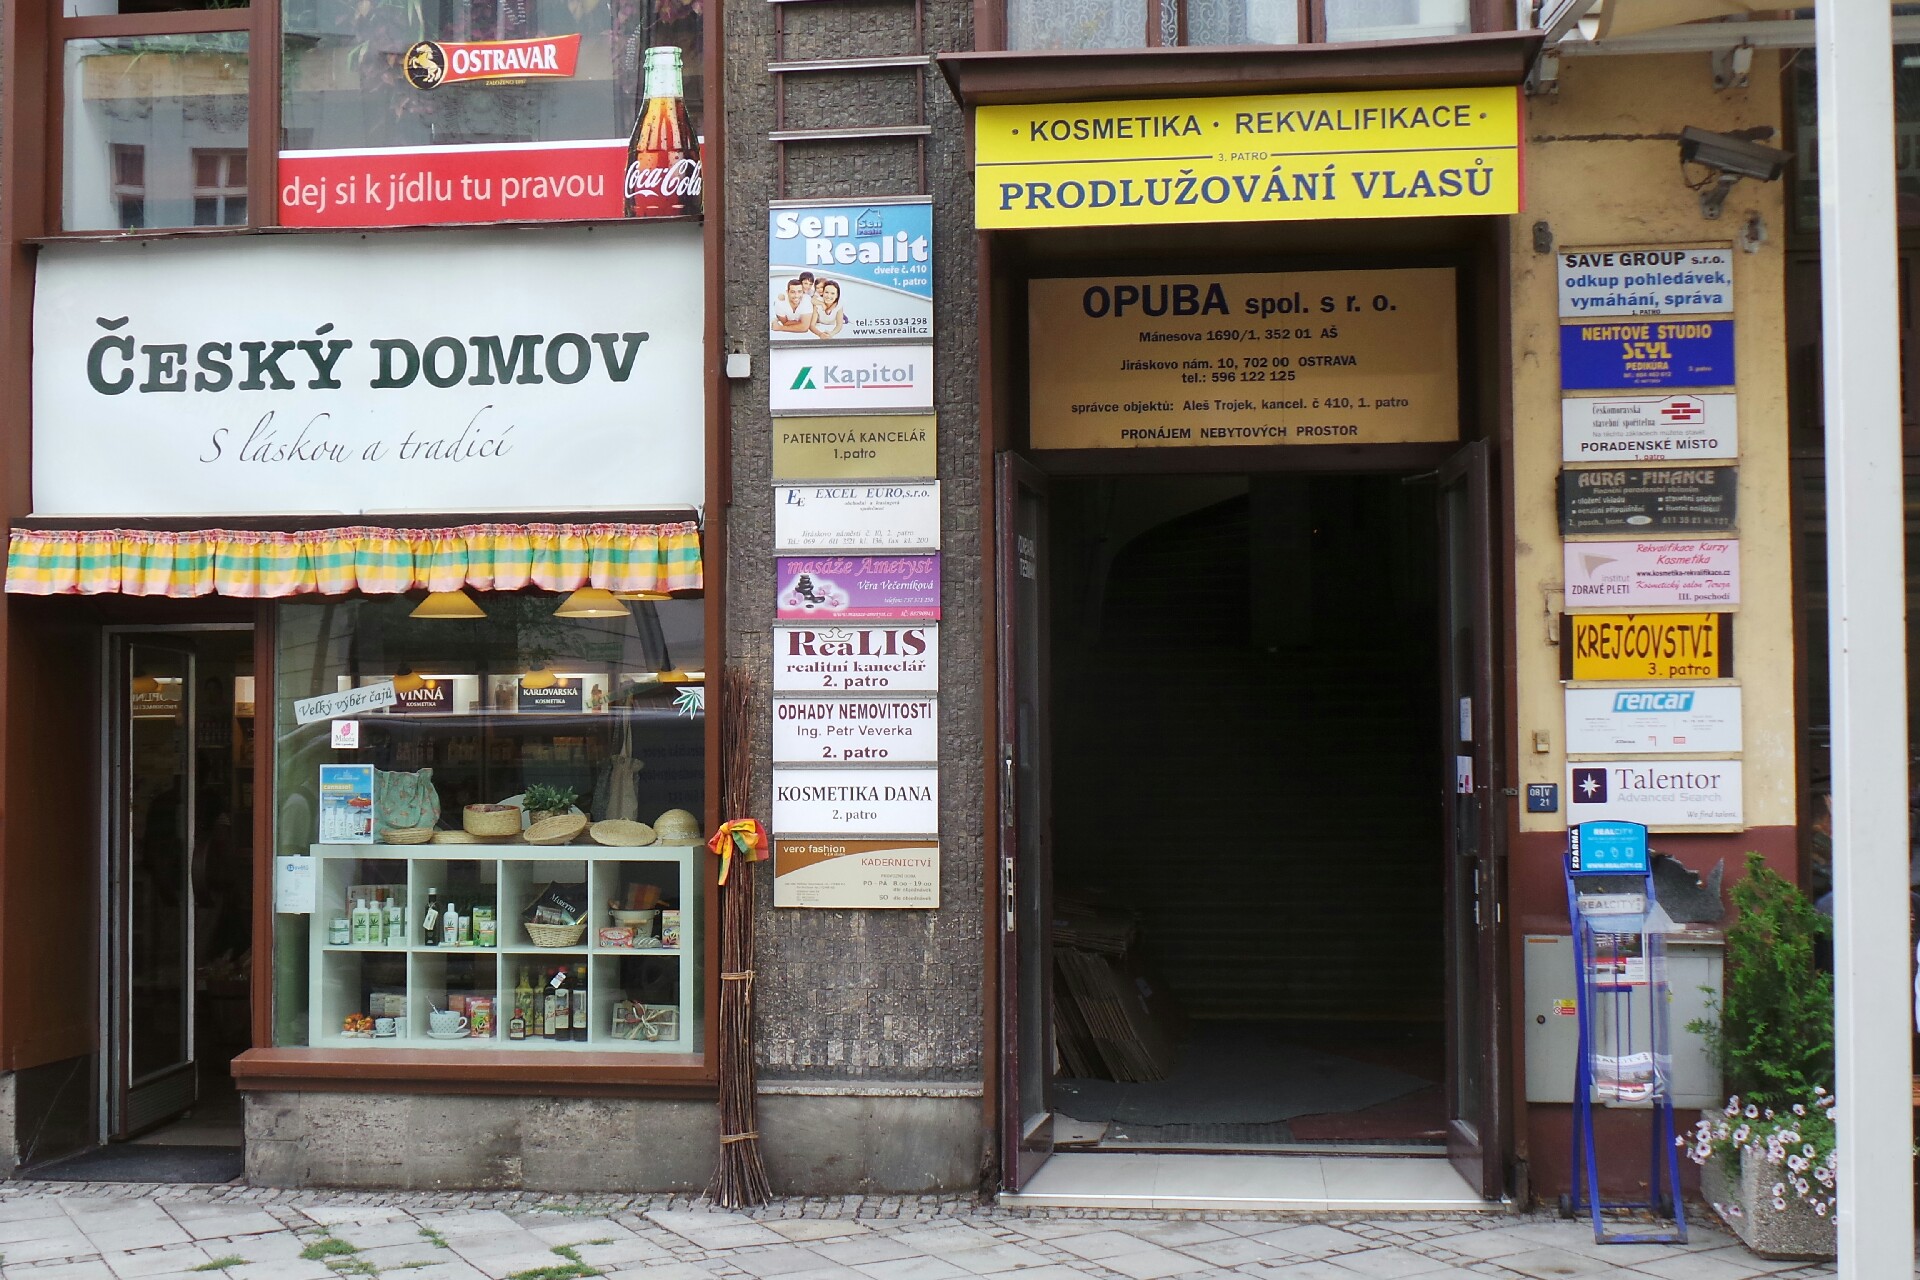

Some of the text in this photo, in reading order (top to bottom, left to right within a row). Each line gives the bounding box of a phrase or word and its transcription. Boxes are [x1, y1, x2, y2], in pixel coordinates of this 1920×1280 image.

[452, 44, 558, 74] OSTRAVAR
[1030, 104, 1471, 142] KOSMETIKA REKVALIFIKACE
[1218, 151, 1269, 162] 3. PATRO
[282, 171, 604, 213] dej si k jídlu tu pravou
[999, 157, 1494, 211] PRODLUŽOVÁNÍ VLASŮ
[775, 212, 849, 239] Sen
[805, 230, 928, 265] Realit
[1565, 251, 1725, 268] SAVE GROUP s.r.o.
[874, 265, 900, 275] dveře
[910, 264, 927, 273] 410
[893, 277, 927, 288] 1. patro
[1565, 270, 1731, 289] odkup pohledávek,
[1082, 282, 1397, 319] OPUBA spol. s r. o.
[1571, 290, 1723, 310] vymáhání, správa
[856, 317, 928, 327] tel.: 553 034 298
[853, 326, 928, 335] www.senrealit.cz
[1139, 325, 1338, 343] Mánesova 352 01 AŠ
[1582, 324, 1712, 341] NEHTOVÉ STUDIO
[87, 316, 650, 395] ČESKÝ DOMOV
[1120, 355, 1358, 371] Jiráskovo nám. 10, 702 00 OSTRAVA
[823, 362, 914, 389] Kapitol
[1181, 370, 1296, 383] tel.: 596 122 125
[1071, 396, 1409, 415] správce objektů: Aleš Trojek, kancel. č 410, 1. patro
[1592, 417, 1656, 430] stavební spořitelna
[200, 405, 515, 464] S láskou a tradicí
[783, 428, 926, 444] PATENTOVÁ KANCELÁŘ
[1121, 425, 1358, 440] PRONÁJEM NEBYTOVÝCH PROSTOR
[1581, 436, 1718, 452] PORADENSKÉ MÍSTO
[1578, 470, 1715, 488] AURA FINANCE
[815, 488, 858, 499] EXCEL
[801, 529, 832, 538] Jiráskovo
[1636, 542, 1729, 553] Rekvalifikace Kurzy
[1656, 554, 1711, 565] Kosmetika
[787, 556, 933, 580] masáže Ametyst
[857, 579, 934, 592] Věra Večerníková
[1571, 584, 1630, 595] ZDRAVÉ PLETI
[1635, 579, 1681, 590] Kosmetický
[1694, 592, 1731, 602] poschodí
[787, 628, 927, 658] ReaLIS
[1577, 614, 1713, 660] KREJČOVSTVÍ
[786, 659, 927, 673] realitní kancelář
[1648, 662, 1711, 678] 3. patro
[822, 674, 889, 690] 2. patro
[523, 687, 578, 696] KARLOVARSKÁ
[299, 687, 393, 717] Velký výběr čajů
[1615, 691, 1691, 711] rencar
[778, 699, 932, 720] ODHADY NEMOVITOSTÍ
[797, 725, 913, 739] Ing. Petr Veverka
[822, 746, 889, 761] 2. patro
[1615, 768, 1721, 790] Talentor
[777, 786, 933, 802] KOSMETIKA DANA
[1617, 792, 1722, 803] Advanced Search
[1539, 798, 1550, 807] 21
[832, 809, 878, 822] 2. patro
[1686, 810, 1714, 819] We find
[783, 844, 846, 854] vero fashion
[1571, 828, 1580, 870] ZDARMA
